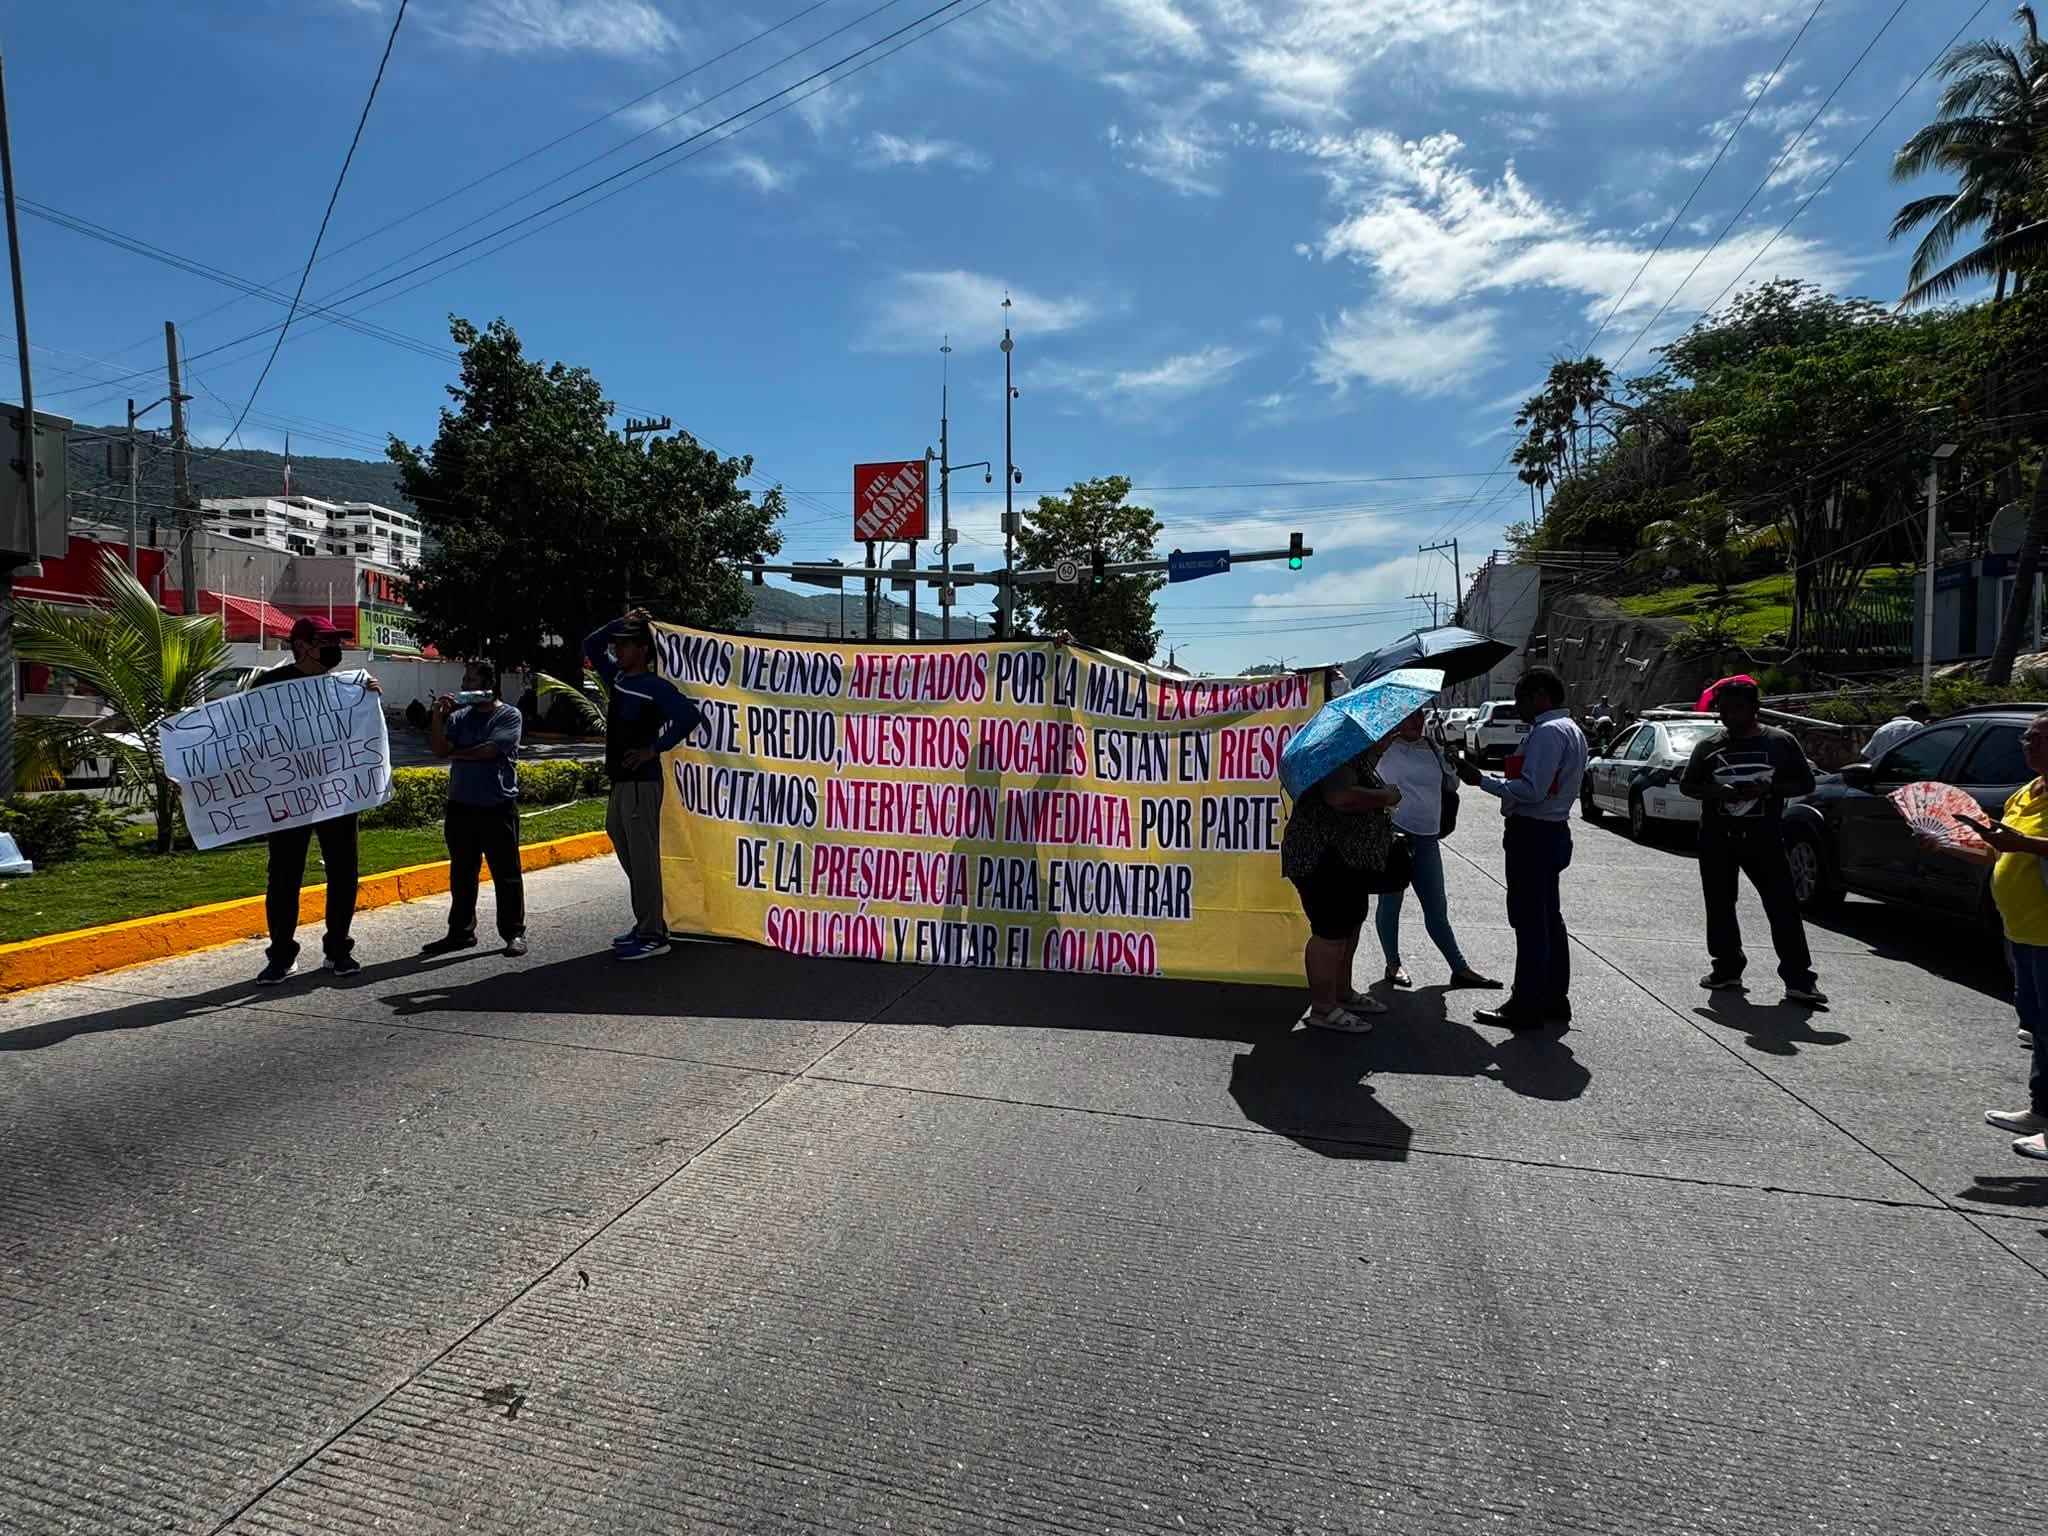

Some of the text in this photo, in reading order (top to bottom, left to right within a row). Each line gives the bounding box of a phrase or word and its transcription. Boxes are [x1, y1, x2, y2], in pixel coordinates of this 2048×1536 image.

[855, 462, 925, 538] HOME
[1061, 565, 1073, 575] 60
[375, 626, 390, 646] 18
[656, 628, 1309, 721] SOMOS VECINOS AFECTADOS POR LA MALA EXCAVACION
[270, 756, 296, 786] 3
[844, 714, 970, 769] NUESTROS
[979, 719, 1087, 776] HOGARES
[1094, 729, 1168, 781] ESTAN
[1179, 730, 1210, 781] EN
[209, 764, 387, 836] DE GOBIERNO
[674, 760, 1280, 850] SOLICITAMOS INTERVENCION INMEDIATA POR PARTE
[737, 838, 1191, 919] DE LA PRESIDENCIA PARA ENCONTRAR
[766, 902, 884, 961] SOLUCIÓN
[893, 918, 908, 962] Y
[916, 920, 998, 966] EVITAR
